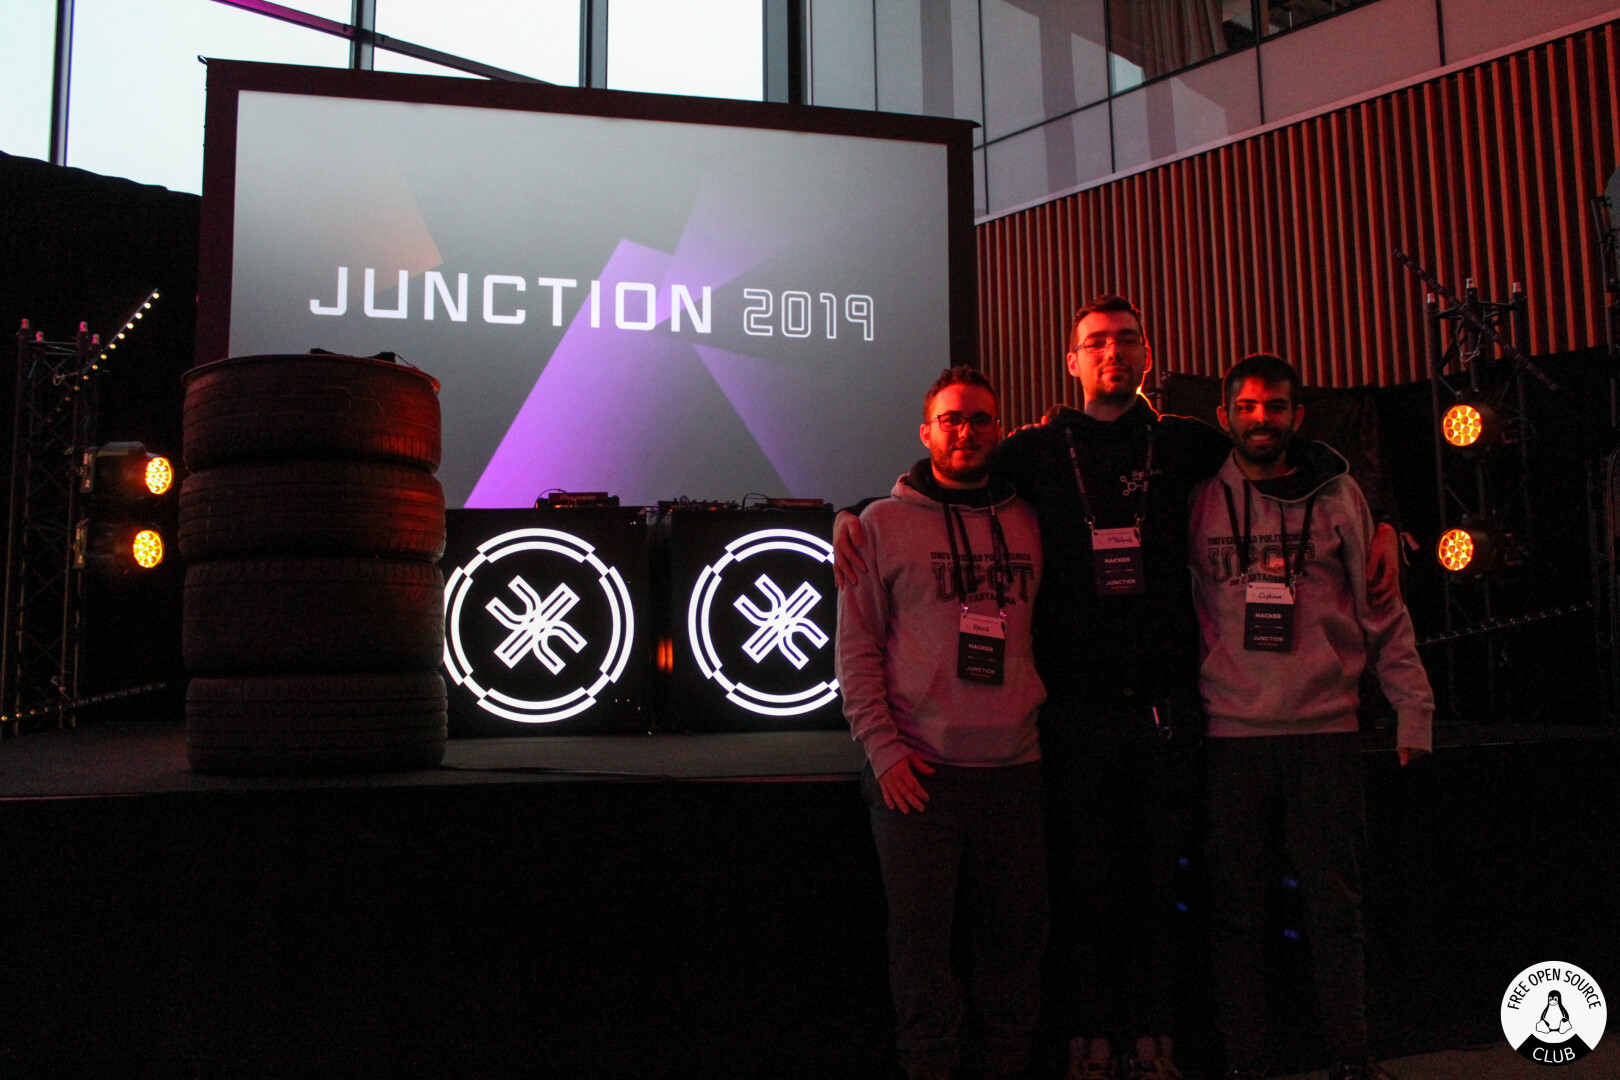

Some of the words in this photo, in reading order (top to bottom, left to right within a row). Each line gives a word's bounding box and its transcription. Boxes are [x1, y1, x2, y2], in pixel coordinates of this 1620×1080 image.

[310, 266, 712, 334] JUNCTION
[743, 287, 875, 342] 2019
[1106, 578, 1136, 586] JUNCTION
[1254, 612, 1282, 620] HACKER
[1252, 635, 1284, 643] JUNCTION
[968, 643, 994, 652] HACKER
[966, 666, 996, 675] JUNCTION
